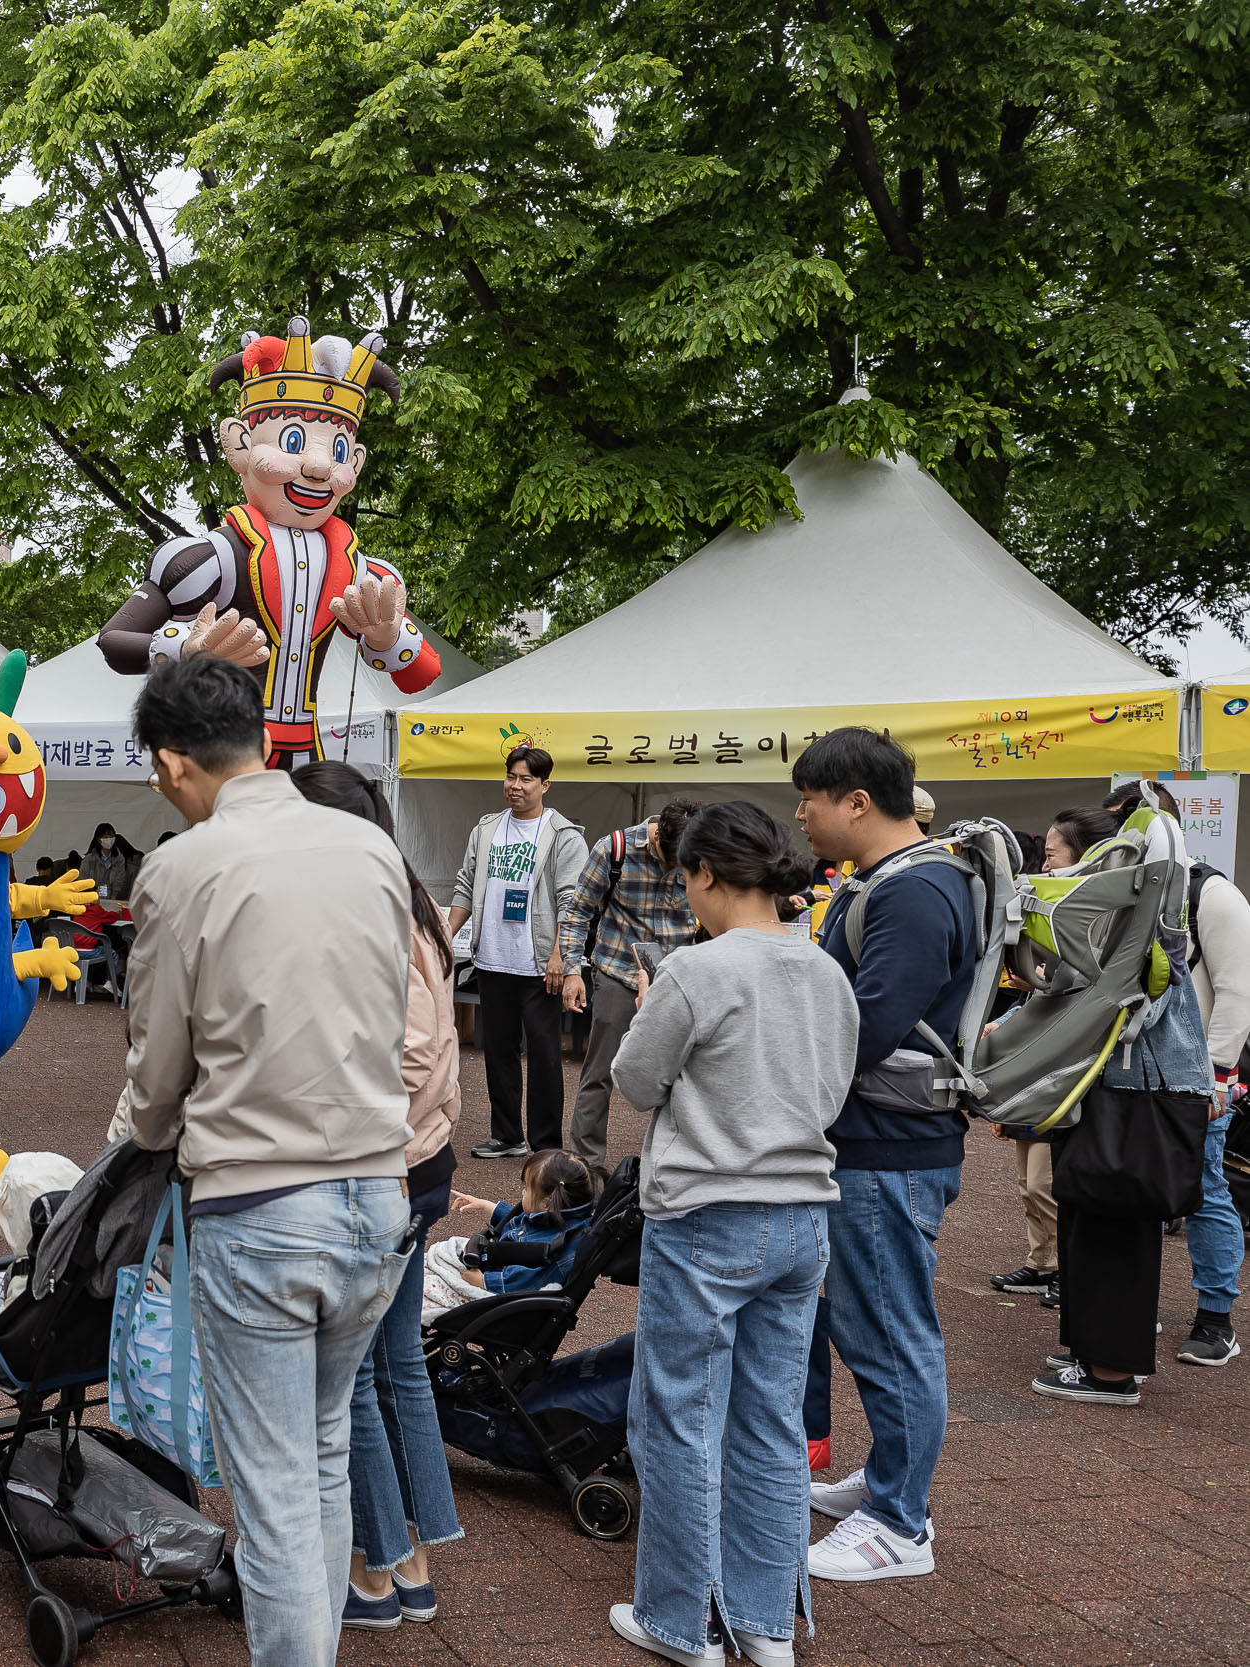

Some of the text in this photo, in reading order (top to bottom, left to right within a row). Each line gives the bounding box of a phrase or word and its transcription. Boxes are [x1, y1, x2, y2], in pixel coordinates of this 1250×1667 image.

[428, 725, 465, 735] 광진구
[585, 730, 890, 765] 글로벌놀이
[496, 855, 513, 867] THE
[506, 901, 525, 909] STAFF
